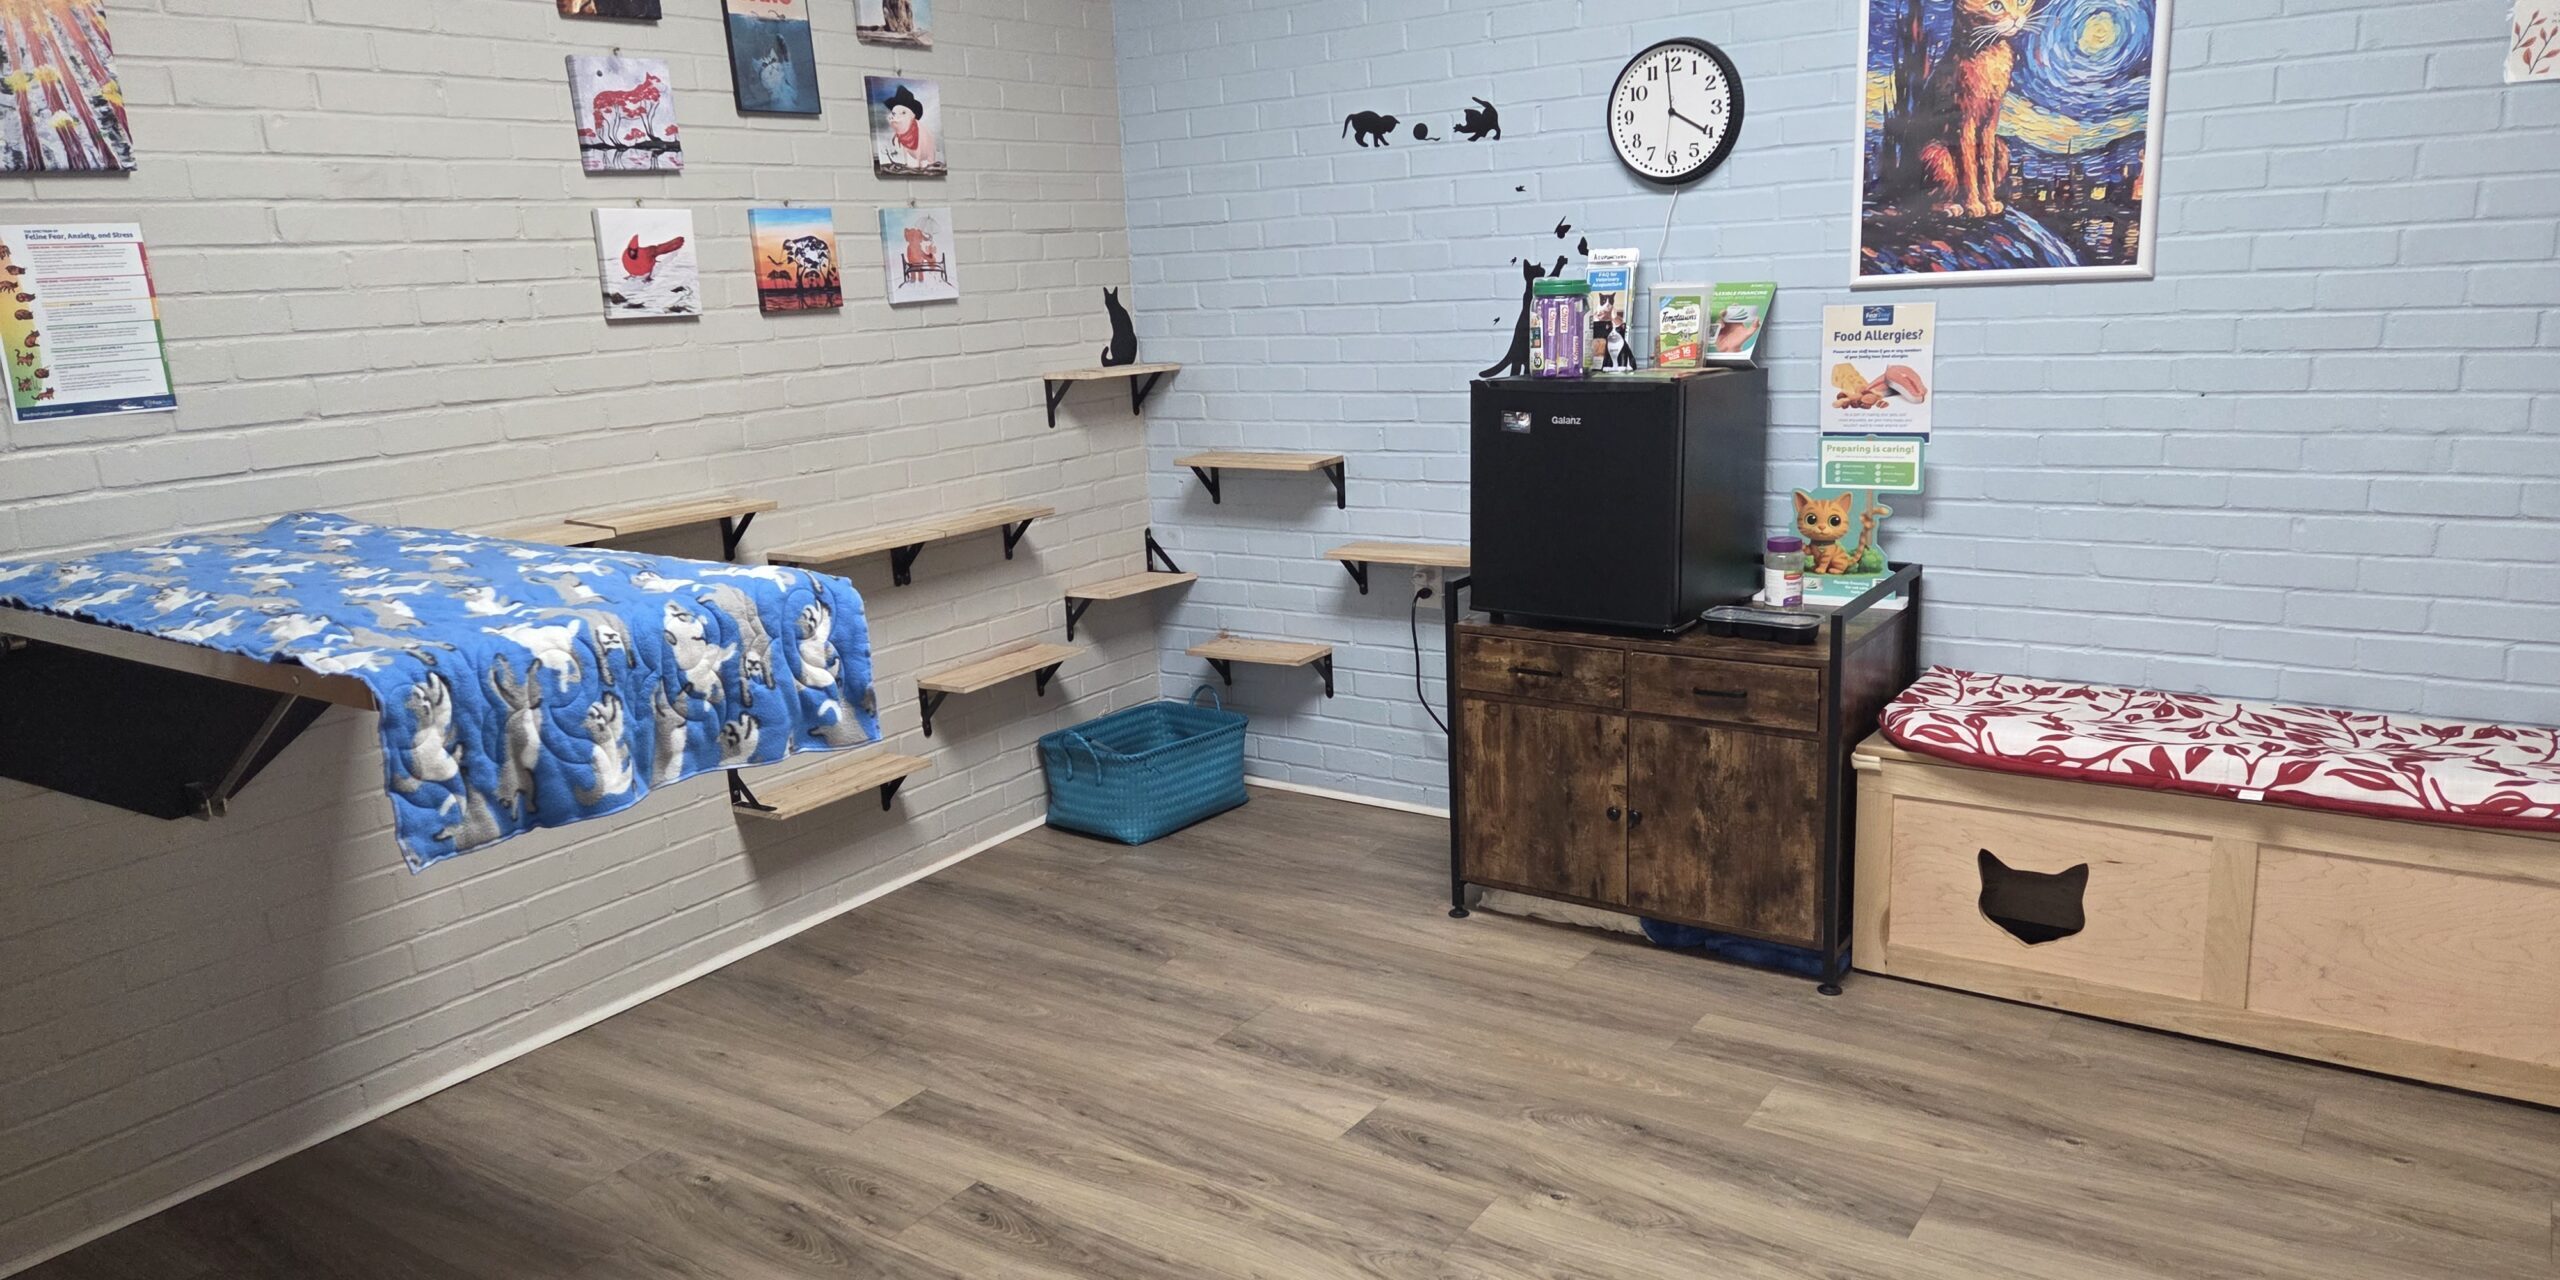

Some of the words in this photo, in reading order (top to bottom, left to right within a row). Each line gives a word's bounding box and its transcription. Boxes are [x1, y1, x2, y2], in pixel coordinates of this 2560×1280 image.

[1647, 65, 1658, 81] 11
[1692, 60, 1697, 75] 1
[1704, 74, 1717, 91] 2
[1630, 85, 1648, 102] 10
[1710, 98, 1723, 115] 3
[1624, 109, 1634, 125] 9
[1703, 124, 1714, 139] 4
[1632, 133, 1642, 149] 8
[1646, 146, 1656, 161] 7
[1689, 142, 1700, 157] 5
[1667, 150, 1678, 166] 6
[48, 233, 67, 241] Fear,
[68, 232, 97, 241] Anxiety,
[1834, 331, 1861, 341] Food
[1864, 329, 1924, 344] Allergies?
[1551, 416, 1582, 425] Galanz
[1827, 445, 1871, 454] Preparing
[1873, 445, 1880, 453] is
[1882, 446, 1914, 455] caring!
